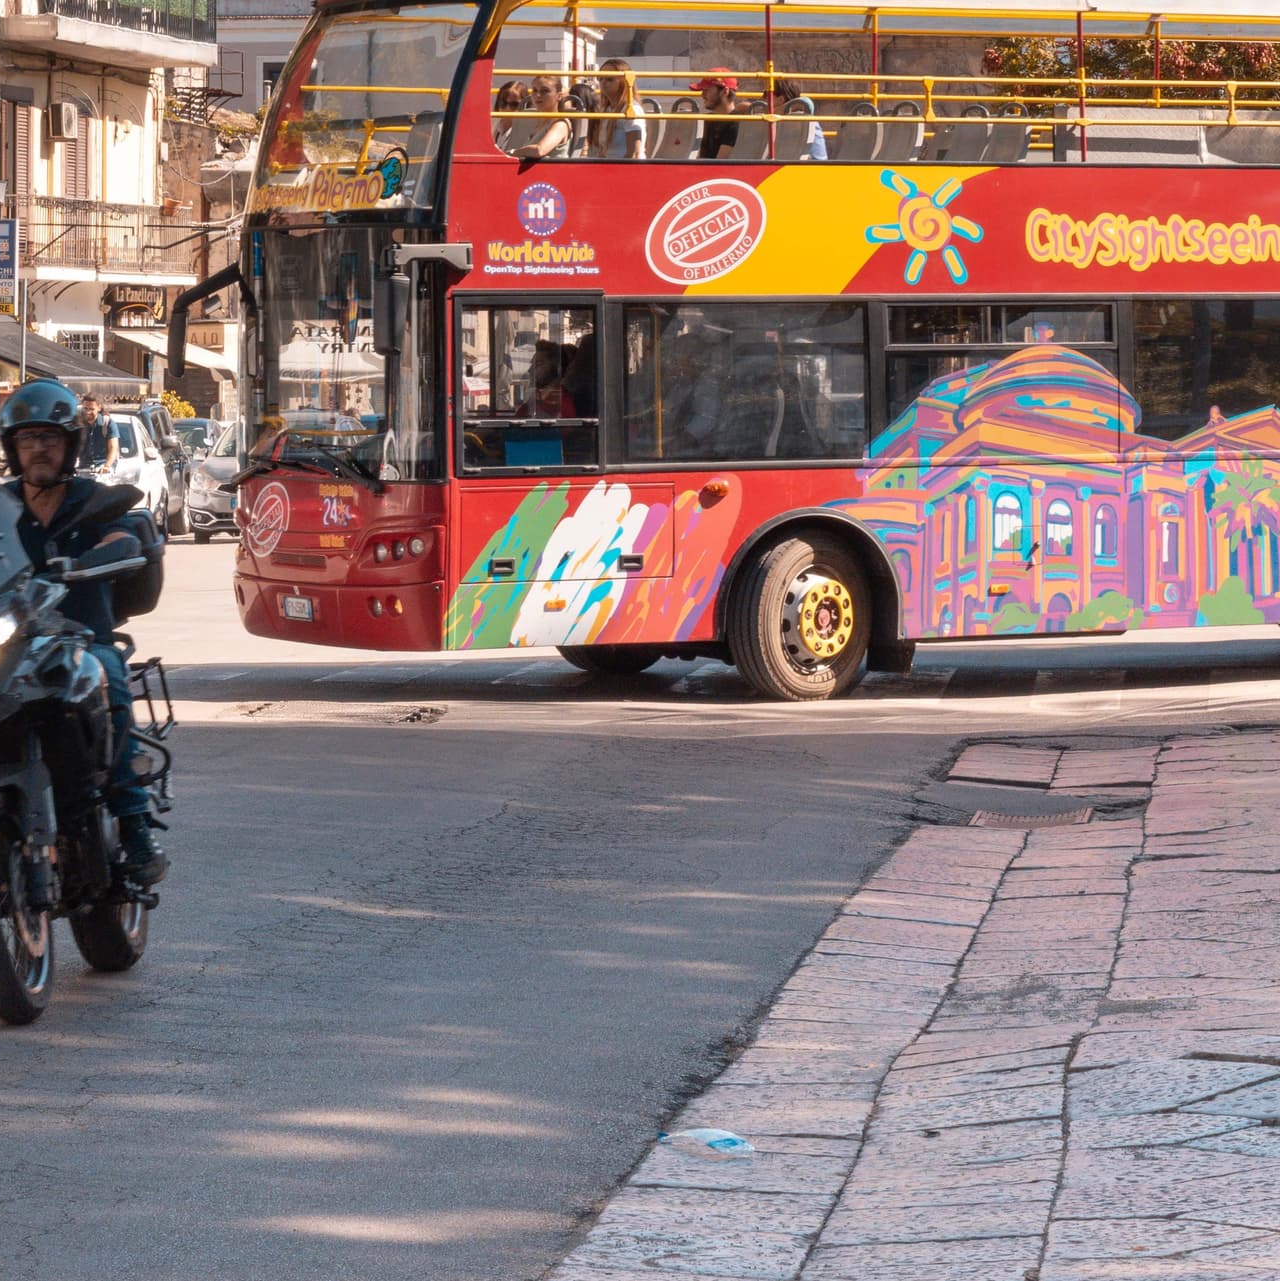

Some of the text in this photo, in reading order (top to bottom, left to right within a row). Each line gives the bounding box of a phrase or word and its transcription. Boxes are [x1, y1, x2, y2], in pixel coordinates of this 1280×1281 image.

[671, 187, 712, 214] TOUR
[668, 206, 745, 257] OFFICIAL
[487, 240, 595, 263] Worldwide
[683, 235, 754, 280] OF PALERMO
[484, 264, 599, 275] OpenTop Sightseeing Tours
